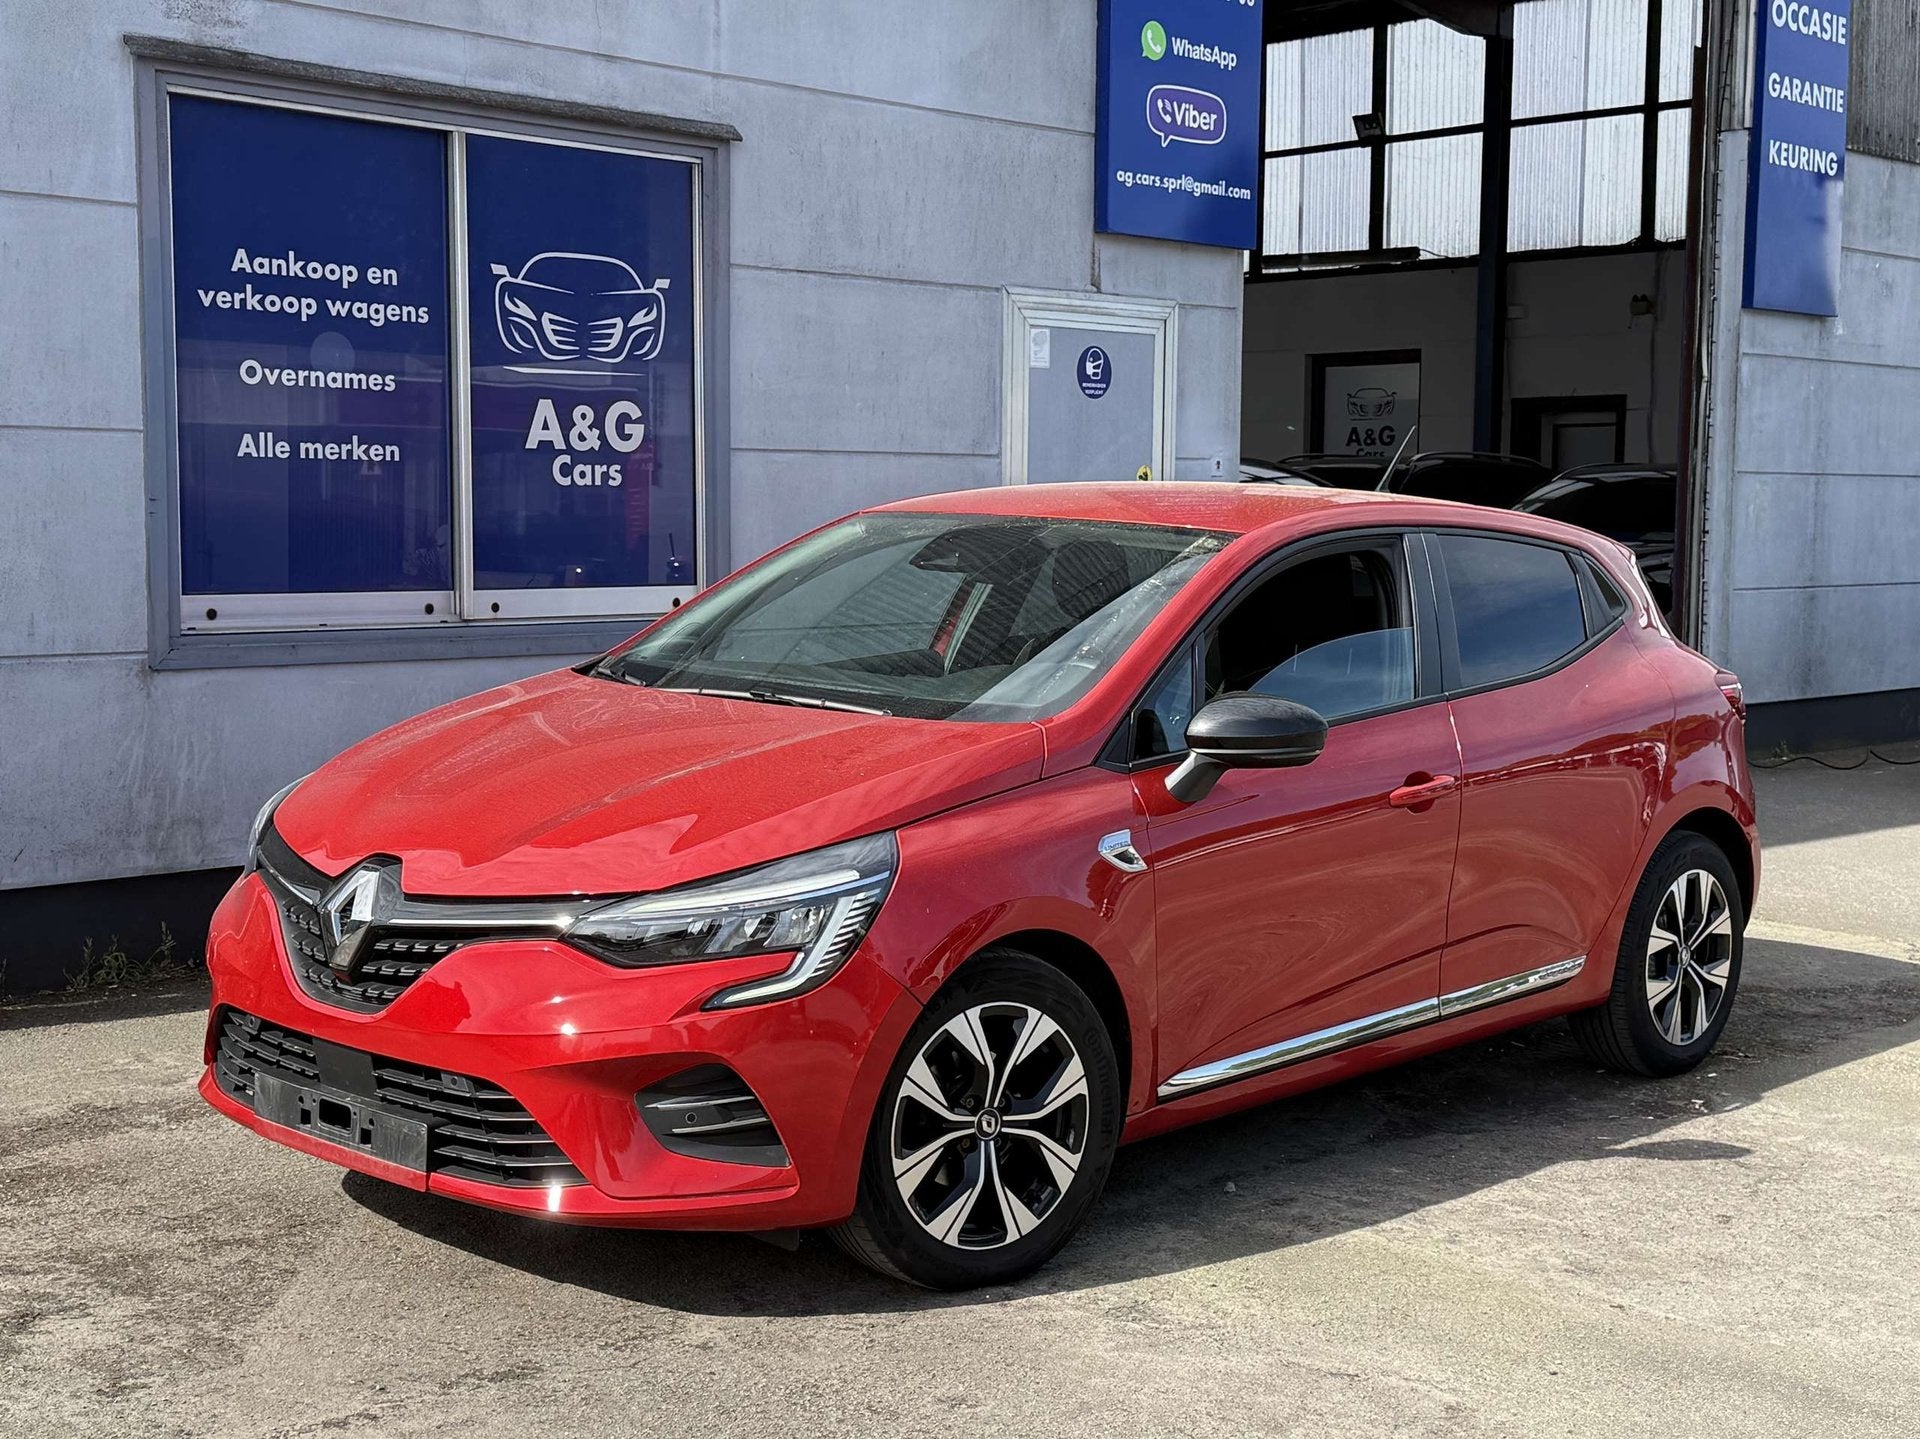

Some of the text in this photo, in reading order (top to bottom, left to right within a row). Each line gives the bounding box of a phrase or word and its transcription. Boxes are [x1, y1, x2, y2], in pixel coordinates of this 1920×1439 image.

[1772, 0, 1847, 45] OCCASIE
[1171, 37, 1237, 71] WhatsApp
[1768, 72, 1844, 113] GARANTIE
[1173, 100, 1218, 131] Viber
[1769, 139, 1838, 177] KEURING
[1116, 170, 1251, 200] ag.cars.sprl@gmail.com
[231, 248, 398, 289] Aankoop en
[198, 287, 429, 327] verkoop wagens
[239, 359, 396, 392] Overnames
[525, 398, 645, 453] A&G
[1346, 425, 1395, 447] A&G
[237, 432, 400, 462] Alle merken
[552, 455, 623, 487] Cars
